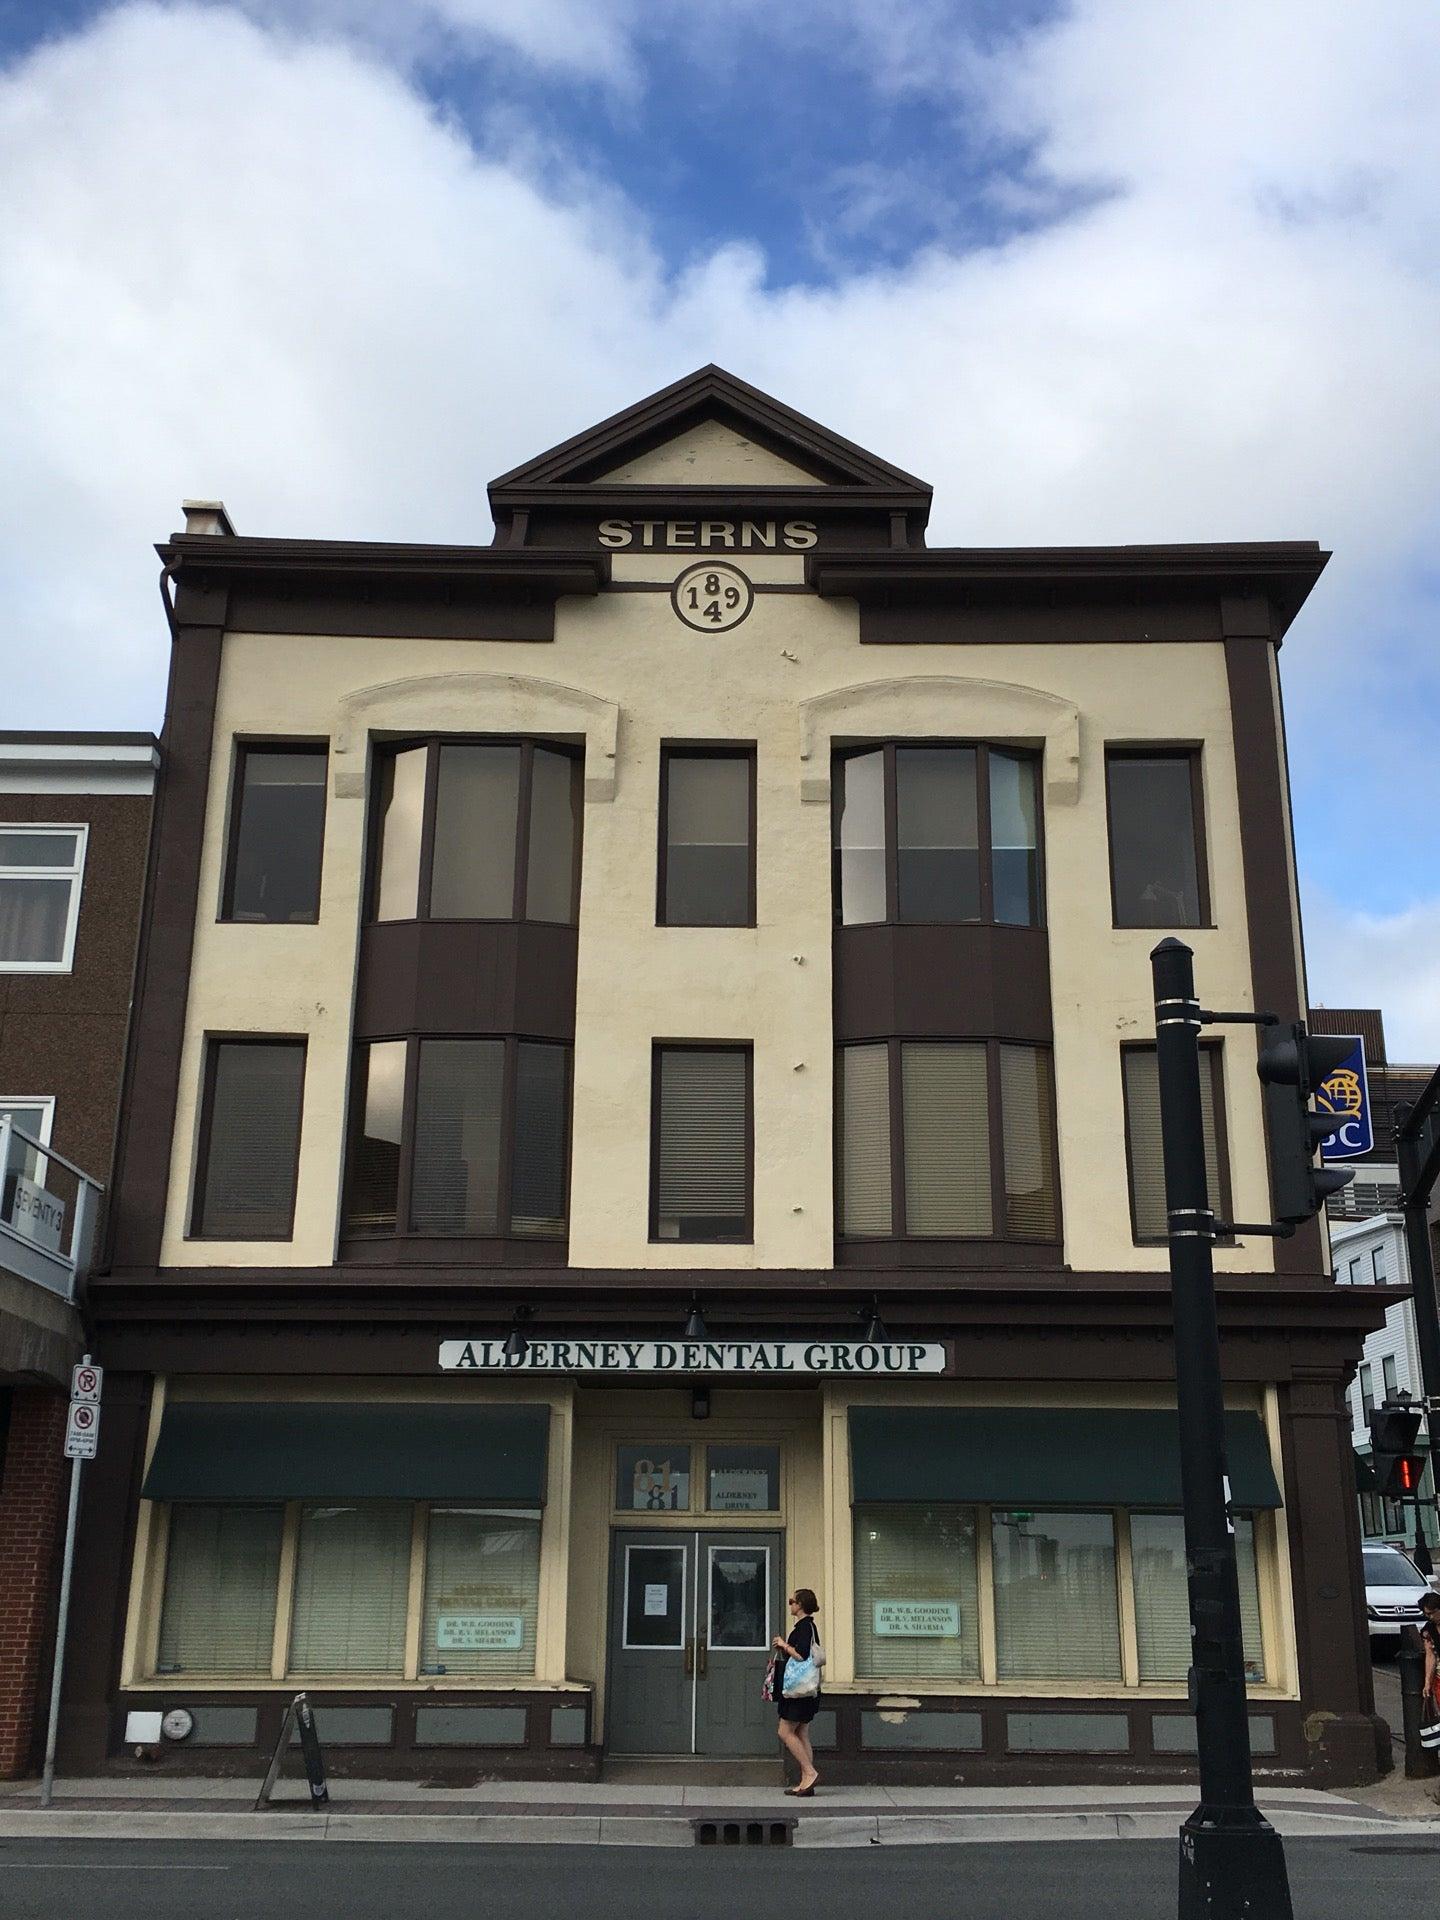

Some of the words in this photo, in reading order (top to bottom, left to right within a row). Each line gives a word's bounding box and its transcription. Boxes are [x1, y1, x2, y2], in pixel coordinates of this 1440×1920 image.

[598, 519, 818, 549] STERNS
[16, 1187, 56, 1227] SEVENTY
[456, 1342, 645, 1368] ALDERNEY
[653, 1343, 794, 1369] DENTAL
[804, 1344, 926, 1370] GROUP
[634, 1459, 671, 1492] 81
